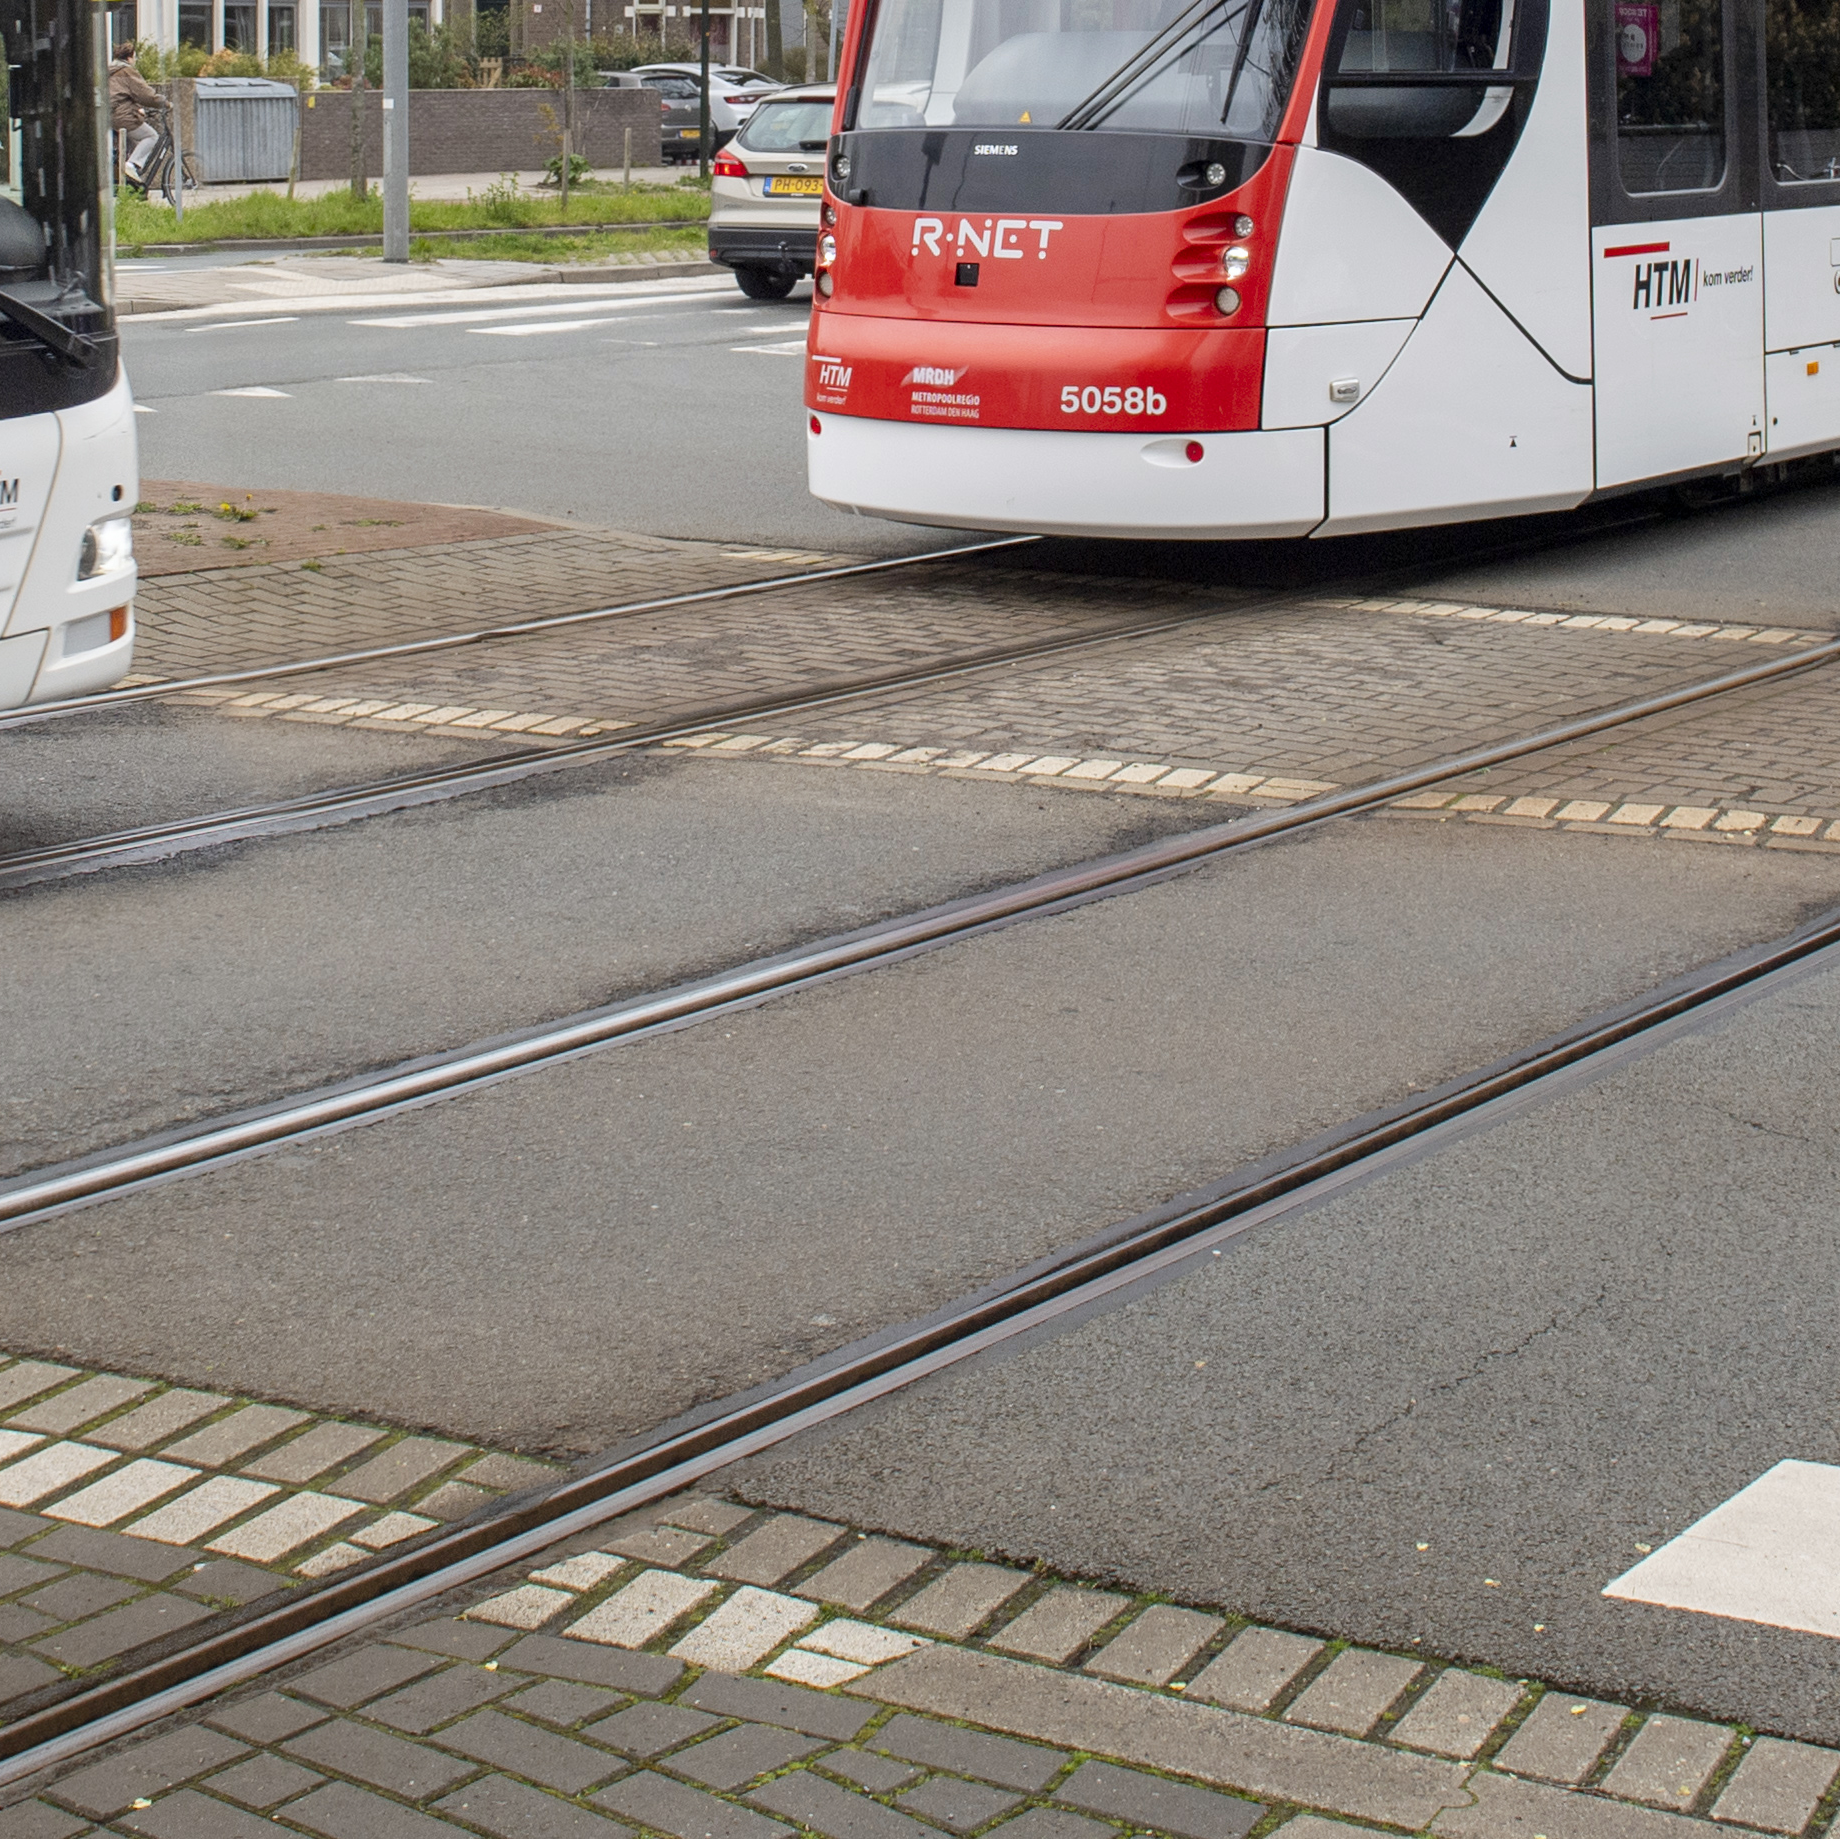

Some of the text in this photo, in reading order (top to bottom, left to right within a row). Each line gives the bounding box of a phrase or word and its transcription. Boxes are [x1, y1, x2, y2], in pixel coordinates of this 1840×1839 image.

[974, 144, 1018, 156] SIEMENS
[1633, 259, 1754, 310] HTM kom verder!
[819, 364, 853, 387] HTM
[913, 366, 954, 386] MRDH
[911, 404, 947, 416] ROTTERDAM
[1060, 385, 1167, 416] 5058b
